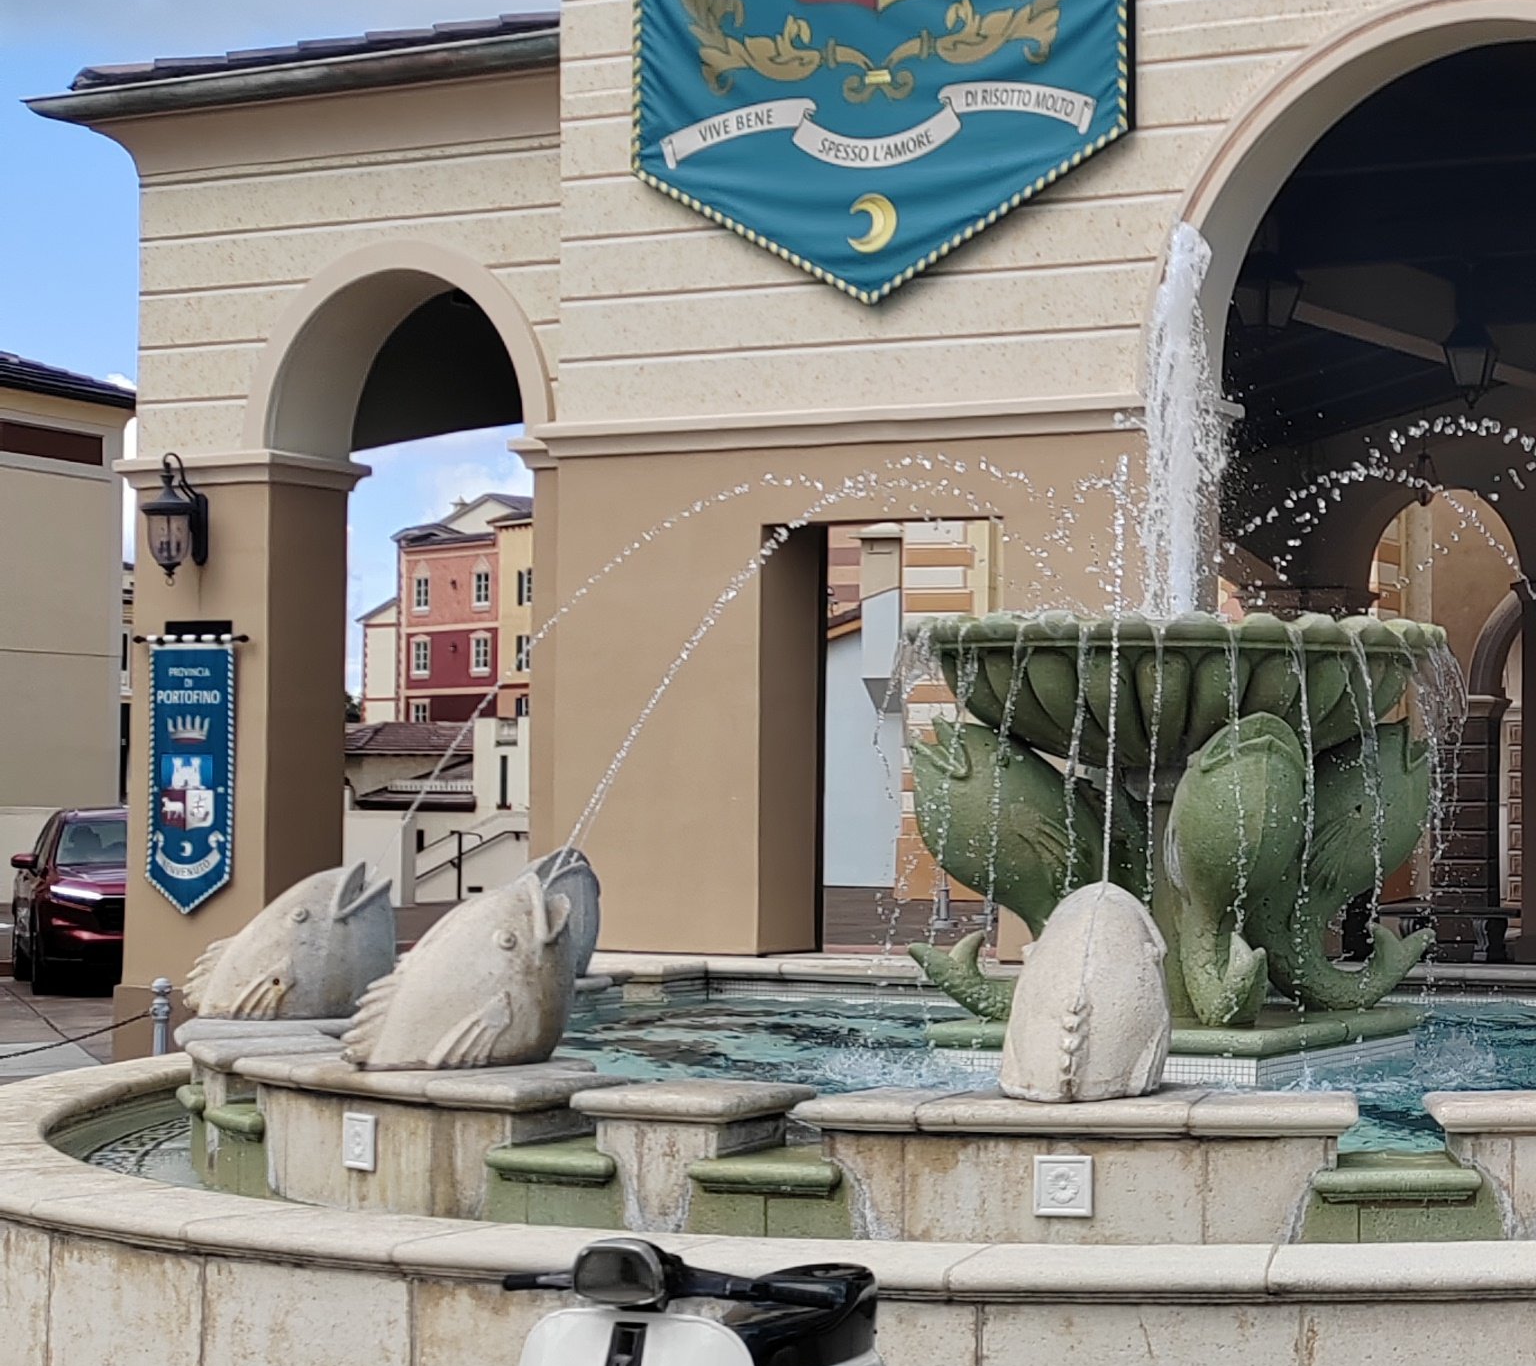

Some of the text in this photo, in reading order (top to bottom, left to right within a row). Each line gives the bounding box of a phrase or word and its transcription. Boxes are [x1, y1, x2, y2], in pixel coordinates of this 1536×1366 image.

[964, 87, 1075, 118] DI RISOTTO MOLTO
[699, 108, 774, 143] VIVE BENE
[818, 131, 934, 162] SPESSO L'AMORE
[168, 667, 211, 677] PROVINCIA
[156, 690, 220, 704] PORTOFINO
